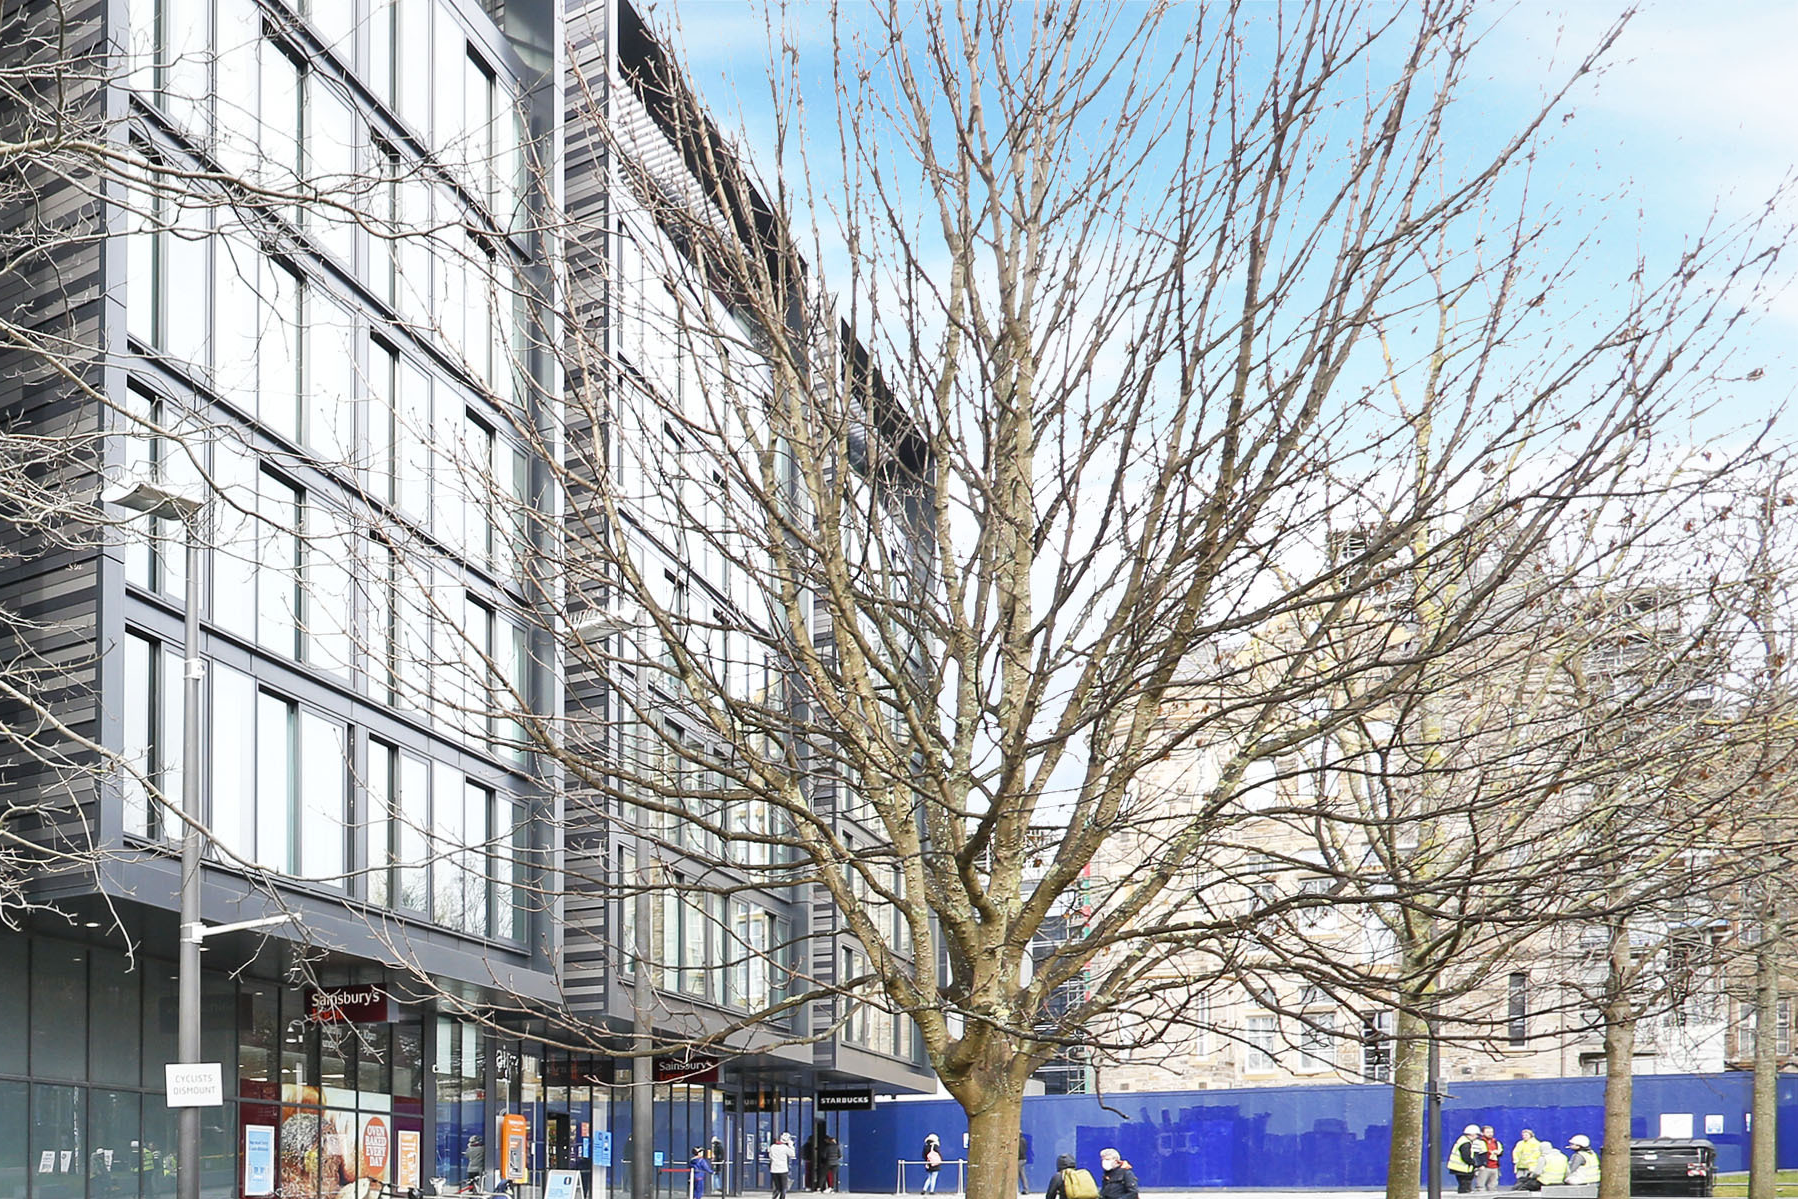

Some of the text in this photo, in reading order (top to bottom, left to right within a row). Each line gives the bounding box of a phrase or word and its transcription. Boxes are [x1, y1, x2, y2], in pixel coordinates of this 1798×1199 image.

[175, 1074, 213, 1083] CYCLISTS
[173, 1086, 215, 1095] DISMOUNT
[820, 1096, 869, 1104] STARBUCKS
[366, 1126, 385, 1136] OVEN
[369, 1157, 383, 1167] DAY
